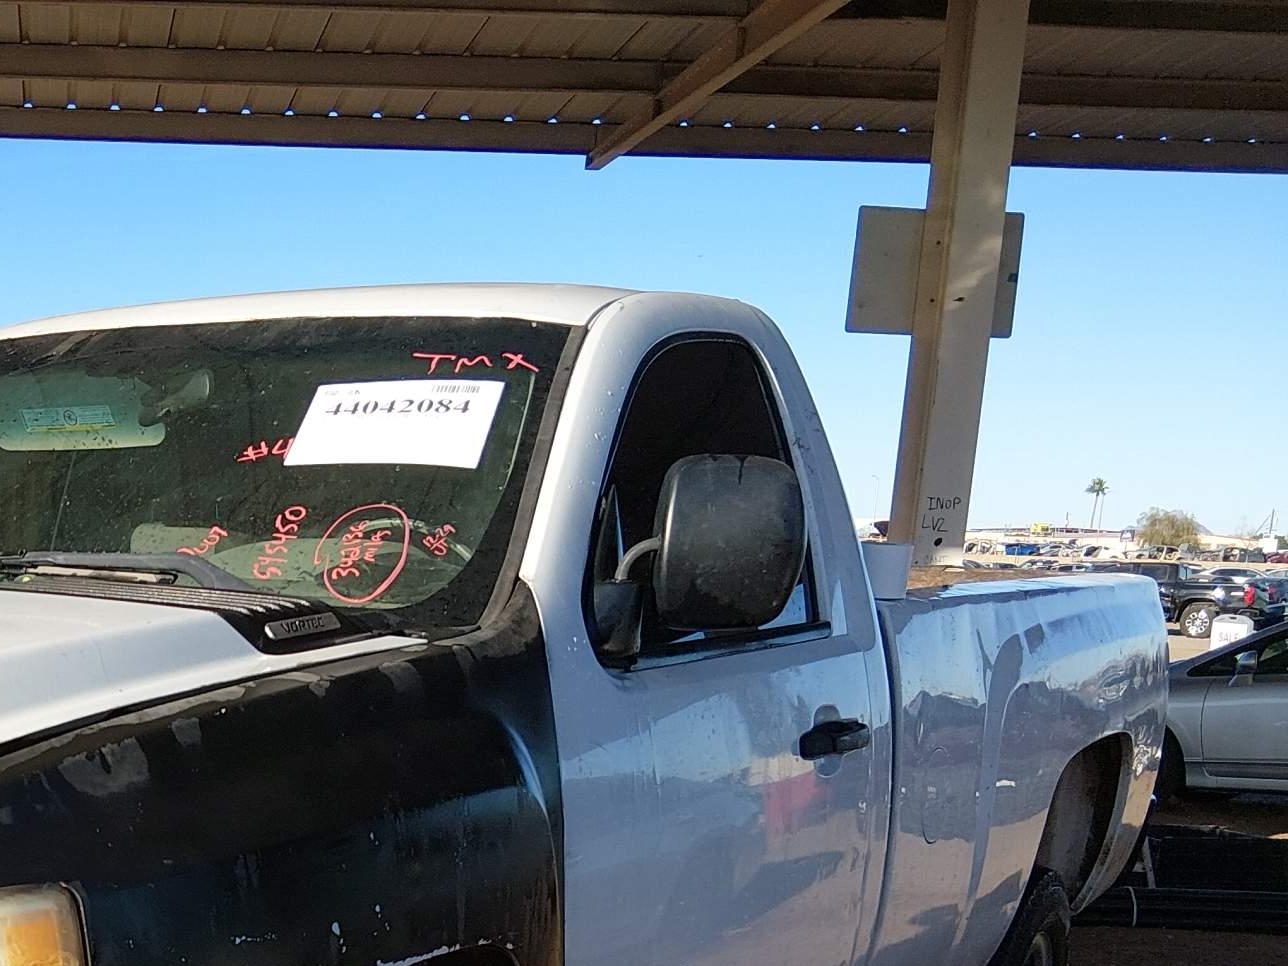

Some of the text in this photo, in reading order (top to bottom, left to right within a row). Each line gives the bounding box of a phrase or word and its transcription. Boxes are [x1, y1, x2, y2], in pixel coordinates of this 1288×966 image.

[412, 352, 540, 376] TMX
[325, 399, 471, 416] 44042084
[279, 616, 326, 634] VORTEC
